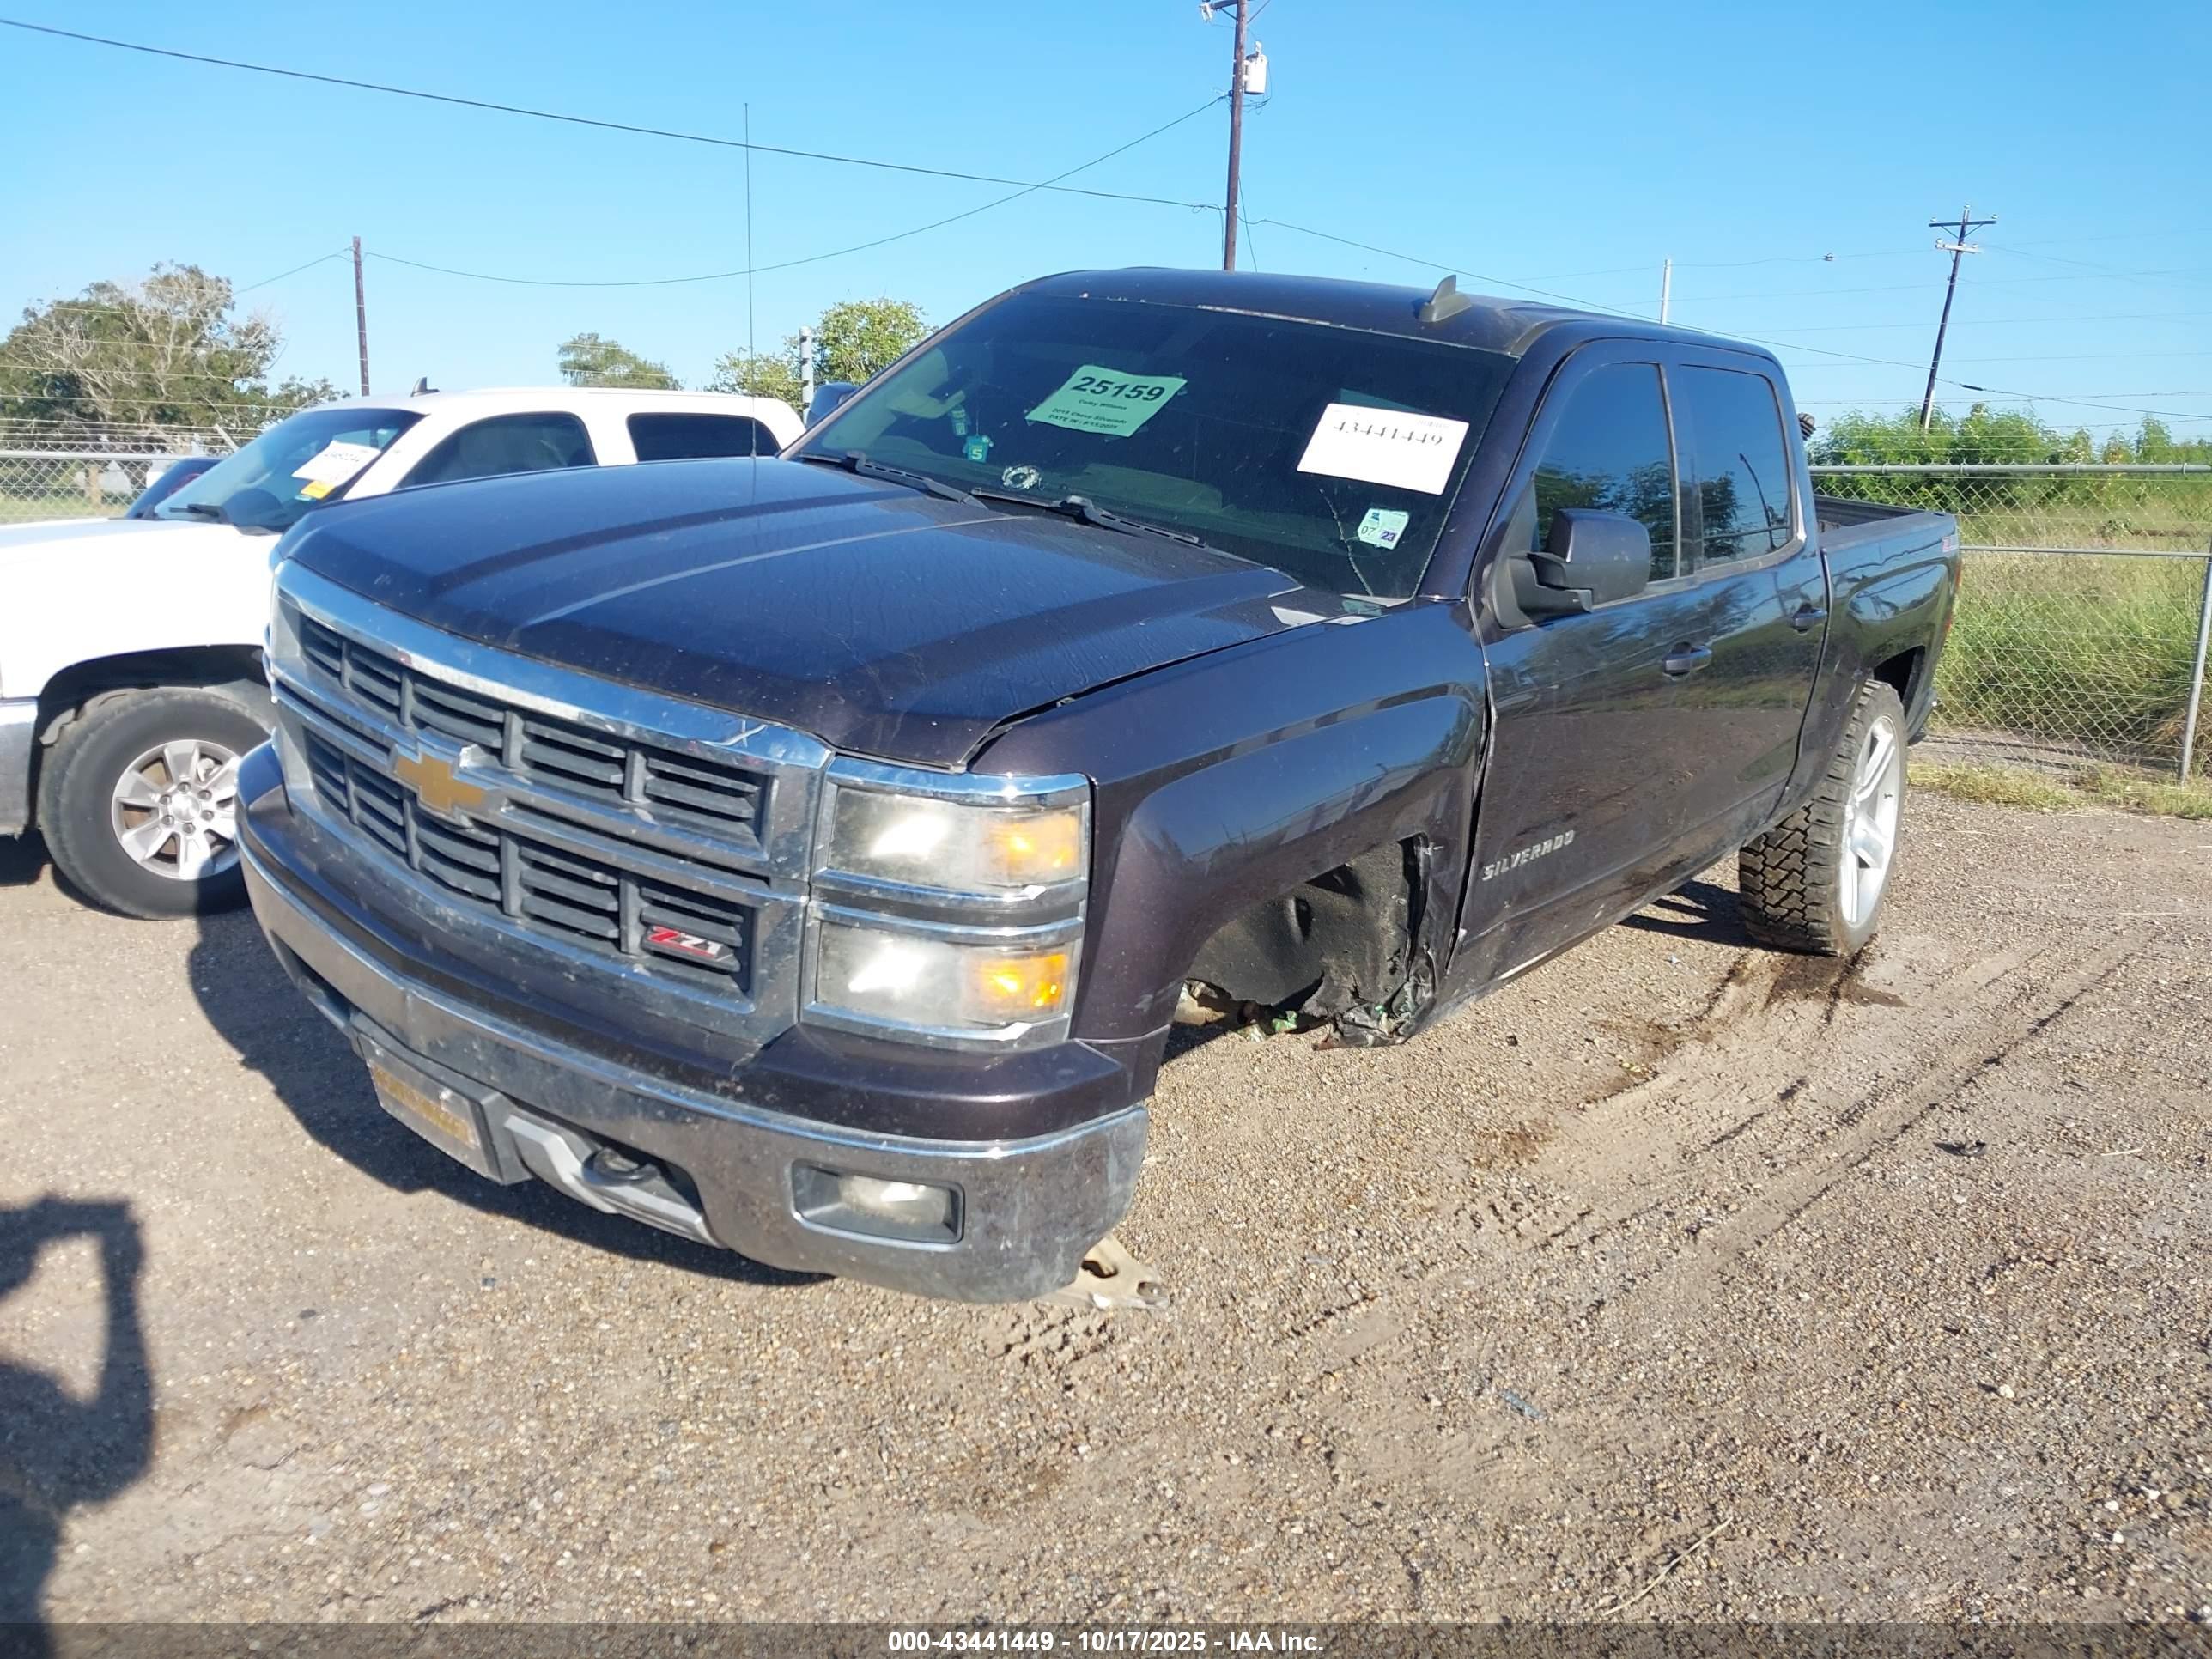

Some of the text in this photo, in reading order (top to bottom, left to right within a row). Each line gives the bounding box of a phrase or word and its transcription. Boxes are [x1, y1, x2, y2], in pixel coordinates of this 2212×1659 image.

[1070, 376, 1165, 402] 25159
[1333, 420, 1443, 447] 43441449
[1361, 525, 1376, 536] 07
[1381, 530, 1398, 542] 23
[1481, 830, 1576, 882] SILVERADO
[646, 924, 726, 959] Z71
